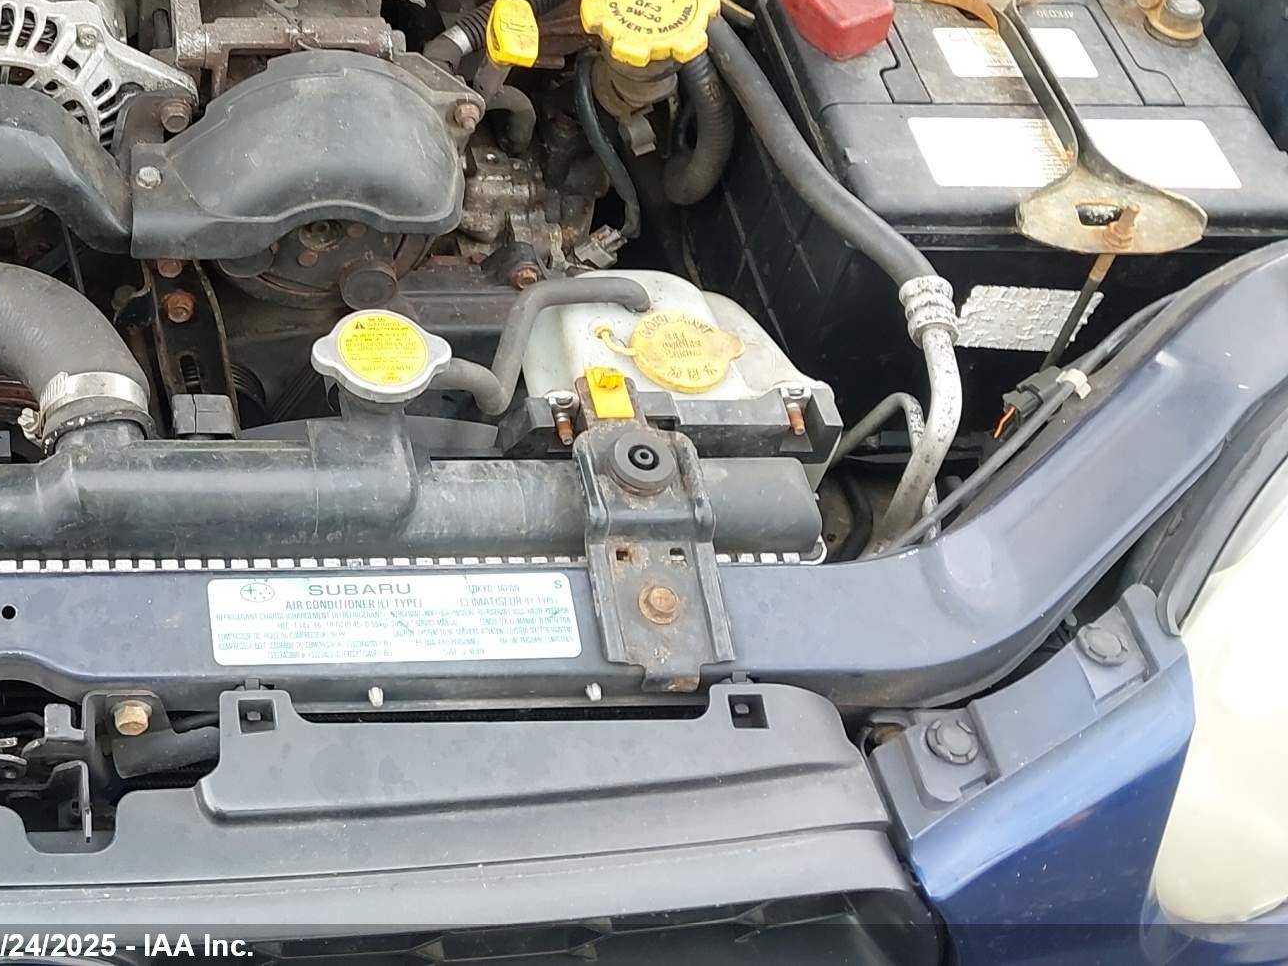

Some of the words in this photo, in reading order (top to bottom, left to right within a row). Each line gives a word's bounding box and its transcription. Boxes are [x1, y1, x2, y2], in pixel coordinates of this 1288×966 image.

[609, 1, 654, 35] OWNER'S
[657, 3, 693, 34] MANUAL
[308, 583, 412, 596] SUBARU
[553, 580, 563, 590] S
[285, 600, 304, 611] AIR
[306, 599, 376, 610] CONDITIONER
